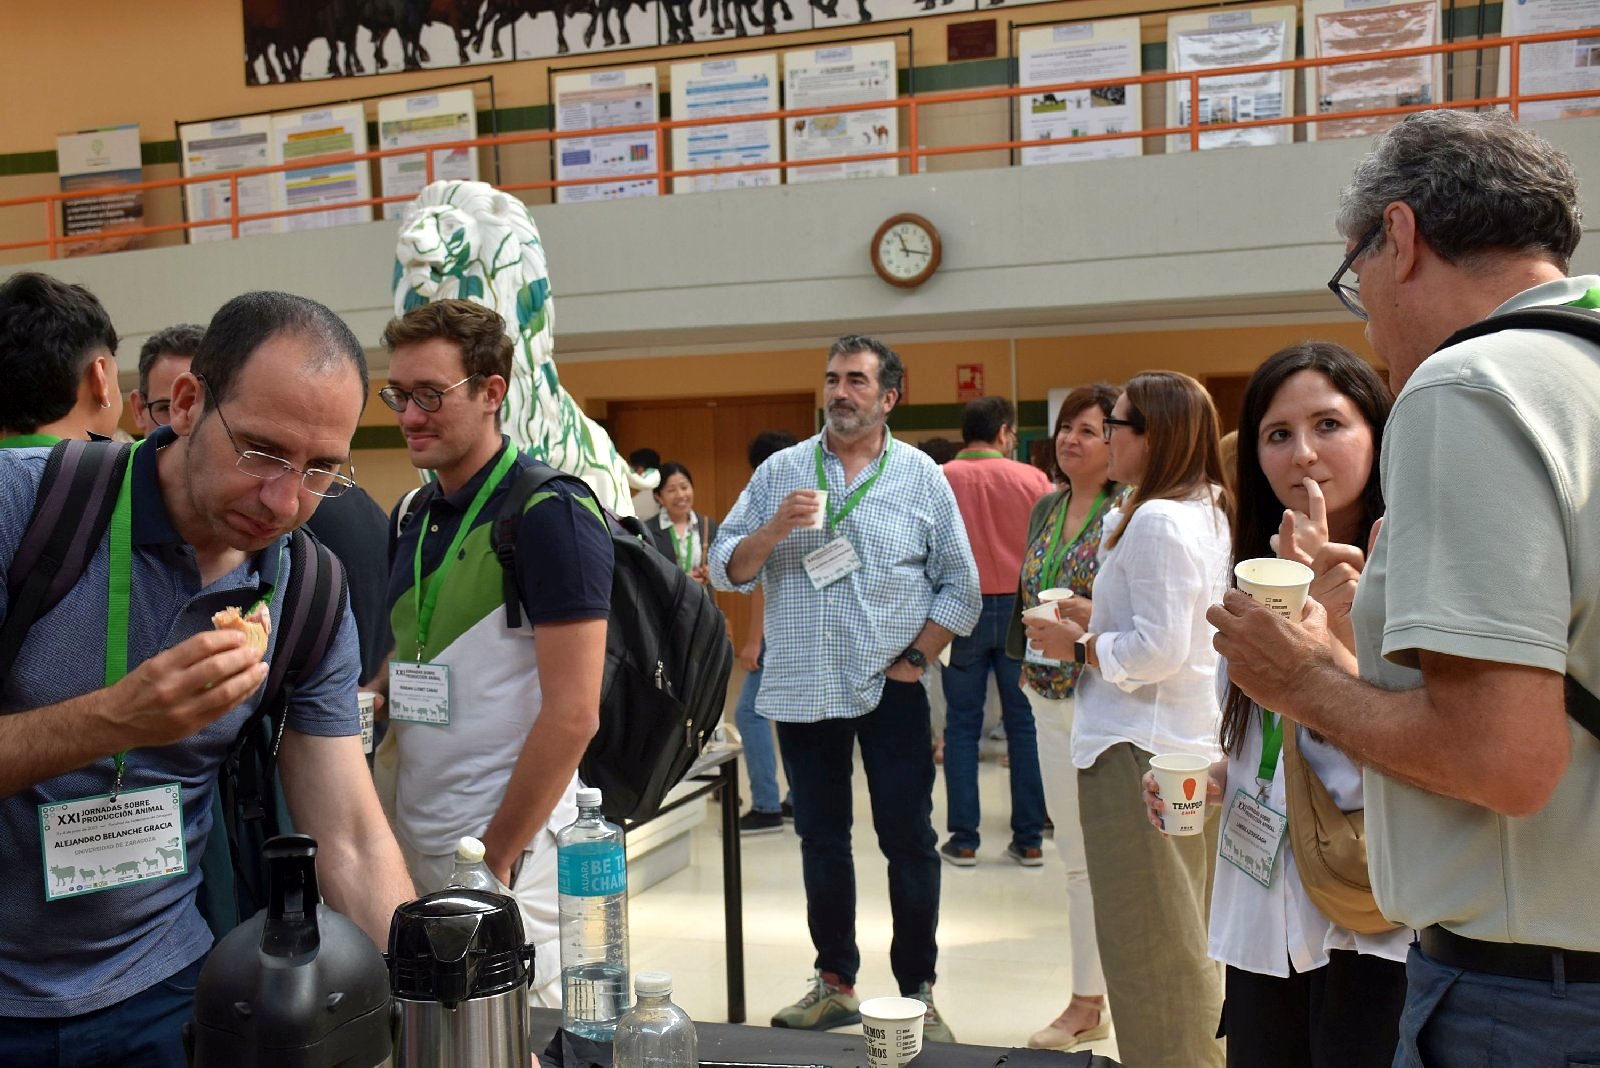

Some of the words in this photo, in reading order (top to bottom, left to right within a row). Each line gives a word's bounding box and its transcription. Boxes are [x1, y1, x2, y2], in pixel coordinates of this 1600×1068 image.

[57, 813, 81, 826] XXI
[81, 810, 133, 825] PRODUCCIÓN
[135, 804, 164, 816] ANIMAL
[81, 804, 122, 817] JORNADAS
[124, 799, 150, 810] SOBRE
[54, 834, 102, 849] ALEJANDRO
[103, 827, 143, 841] BELANCHE
[144, 821, 174, 833] GRACIA
[74, 844, 115, 856] UNIVERSIDAD
[125, 836, 156, 848] ZARAGOZA
[581, 860, 590, 892] AUARA
[591, 858, 612, 875] BE
